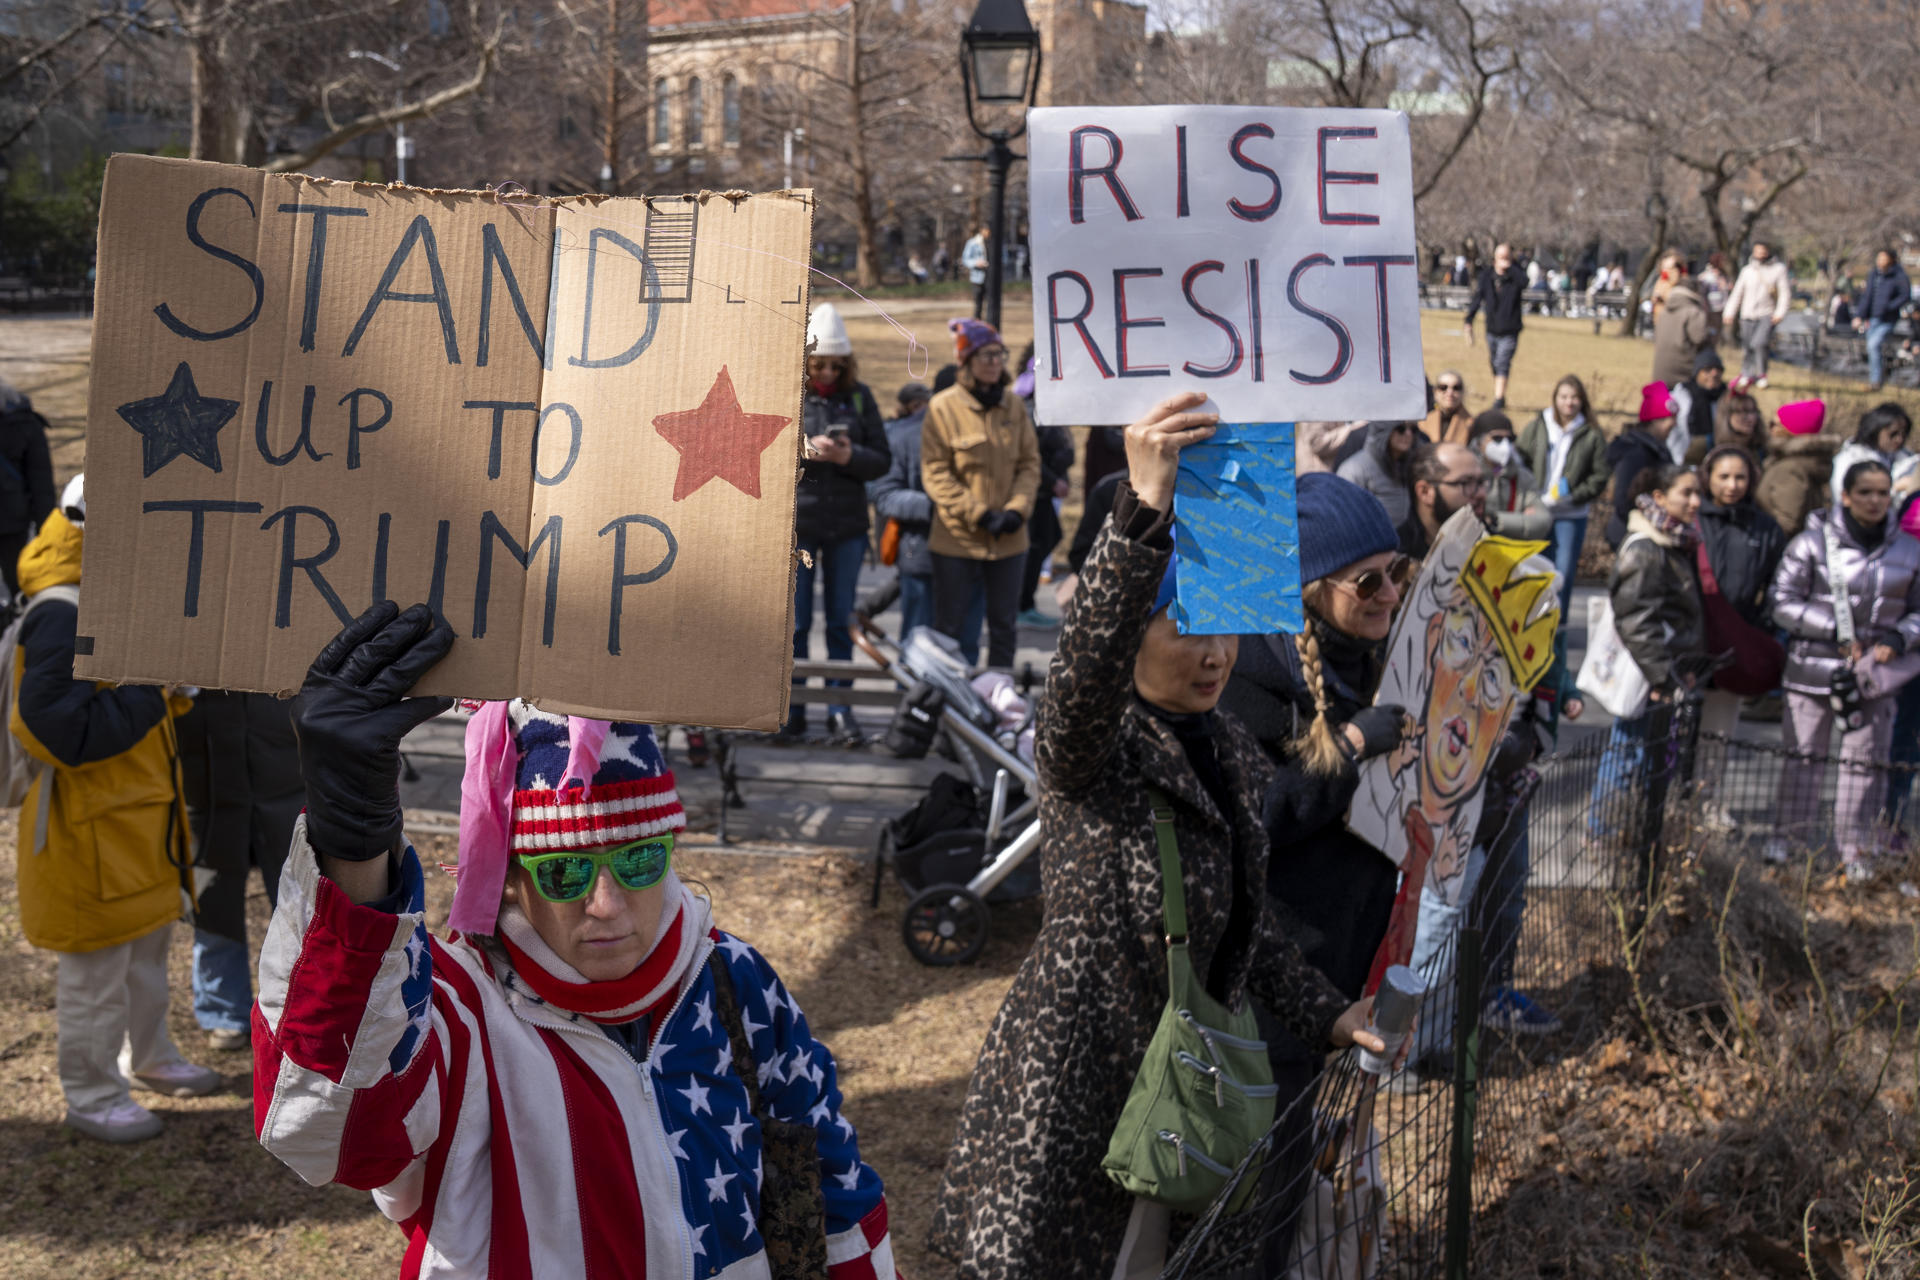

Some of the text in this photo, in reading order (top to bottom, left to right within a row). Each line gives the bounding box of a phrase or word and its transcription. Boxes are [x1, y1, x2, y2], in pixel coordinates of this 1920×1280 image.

[1068, 123, 1380, 225] RISE
[153, 187, 661, 371] STAND
[1047, 253, 1415, 385] RESIST
[464, 400, 583, 487] TO
[143, 498, 679, 656] TRUMP
